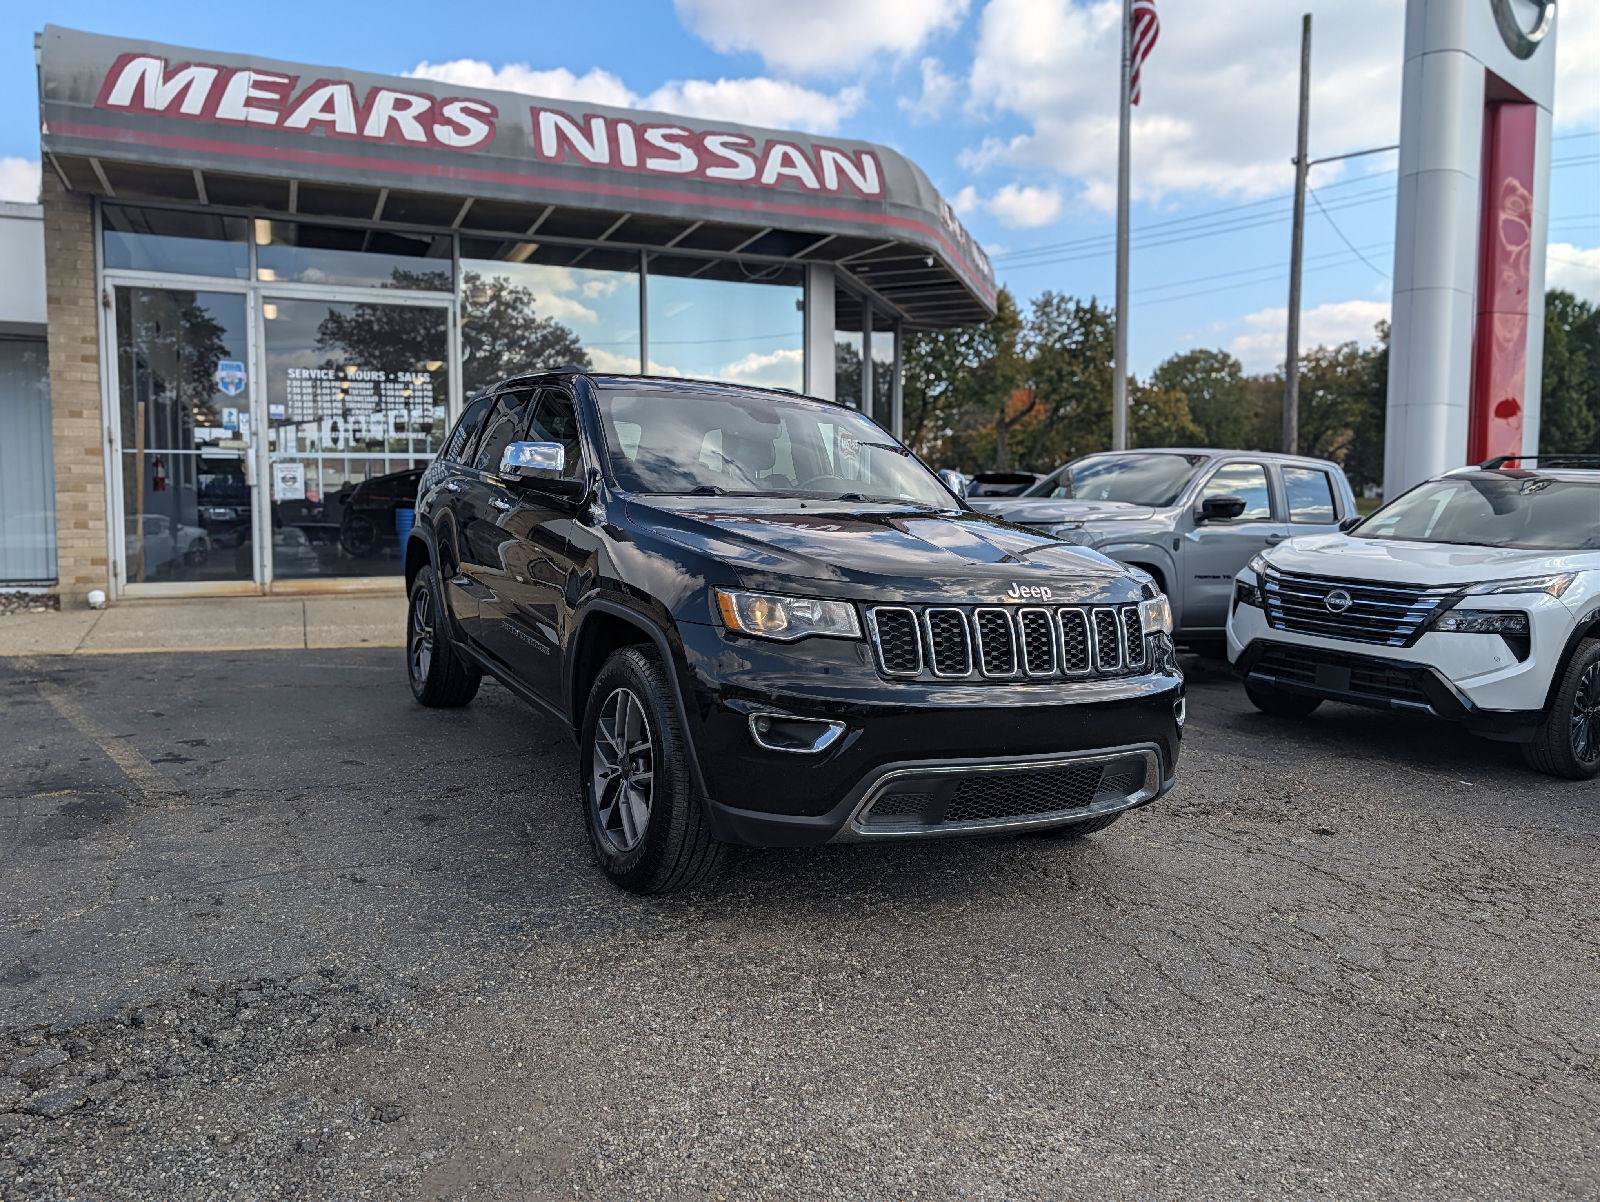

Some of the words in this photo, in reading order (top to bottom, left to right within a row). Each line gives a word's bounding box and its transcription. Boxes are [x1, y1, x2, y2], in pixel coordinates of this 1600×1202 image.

[107, 56, 493, 149] MEARS
[537, 110, 882, 195] NISSAN
[287, 368, 336, 380] SERVICE
[347, 370, 386, 381] HOURS
[397, 372, 431, 383] SALES
[1007, 582, 1052, 602] Jeep
